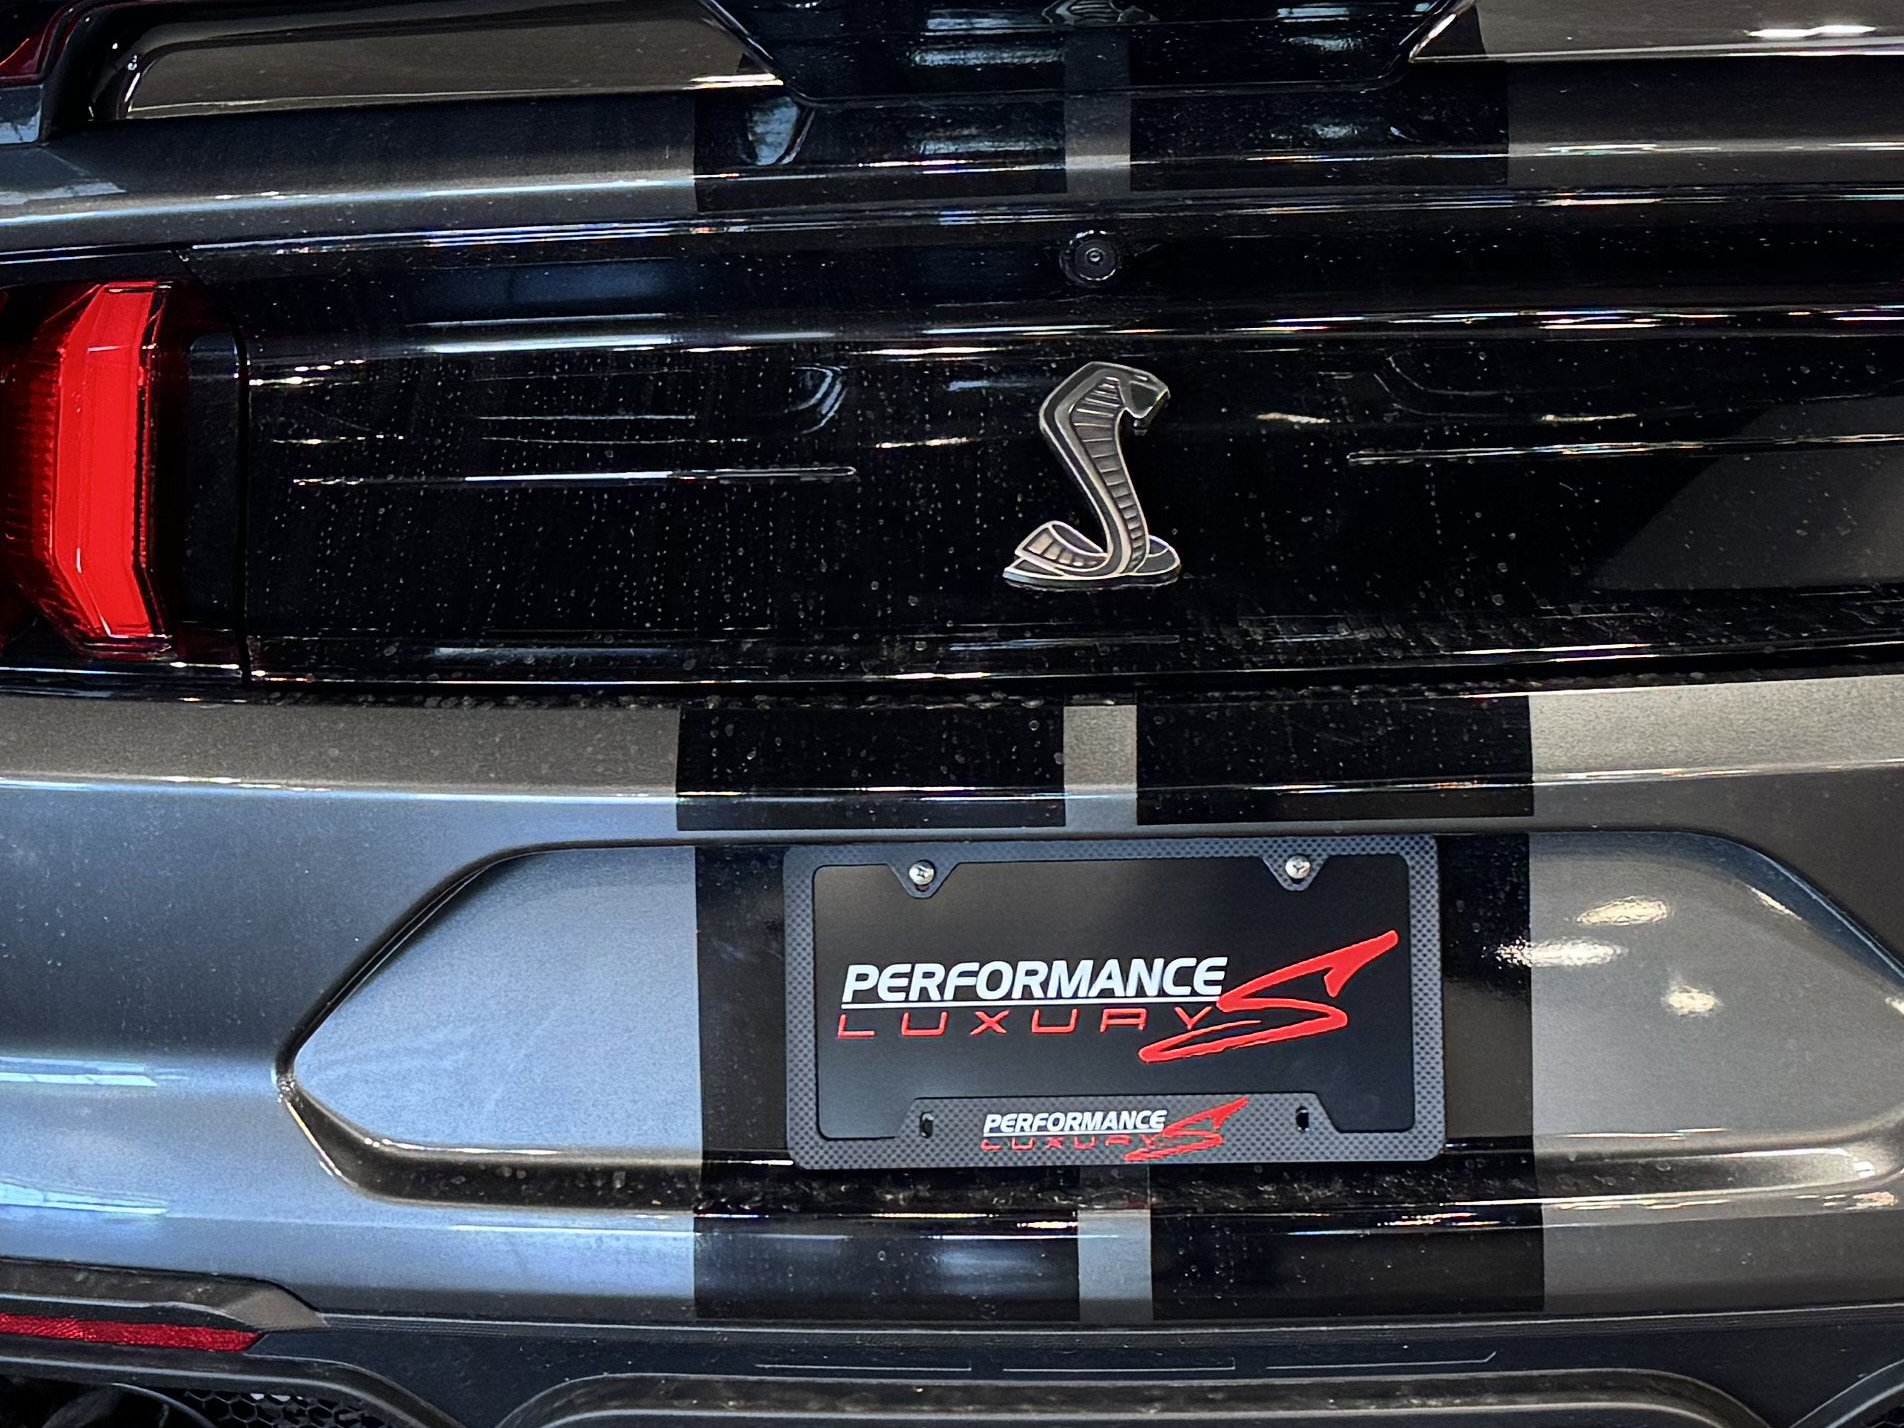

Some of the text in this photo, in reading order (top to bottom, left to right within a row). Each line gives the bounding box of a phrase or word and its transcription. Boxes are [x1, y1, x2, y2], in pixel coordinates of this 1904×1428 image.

[841, 957, 1228, 1003] PERFORMANCE
[837, 1006, 1212, 1039] LUXURY
[984, 1110, 1167, 1134] PERFORMANCE
